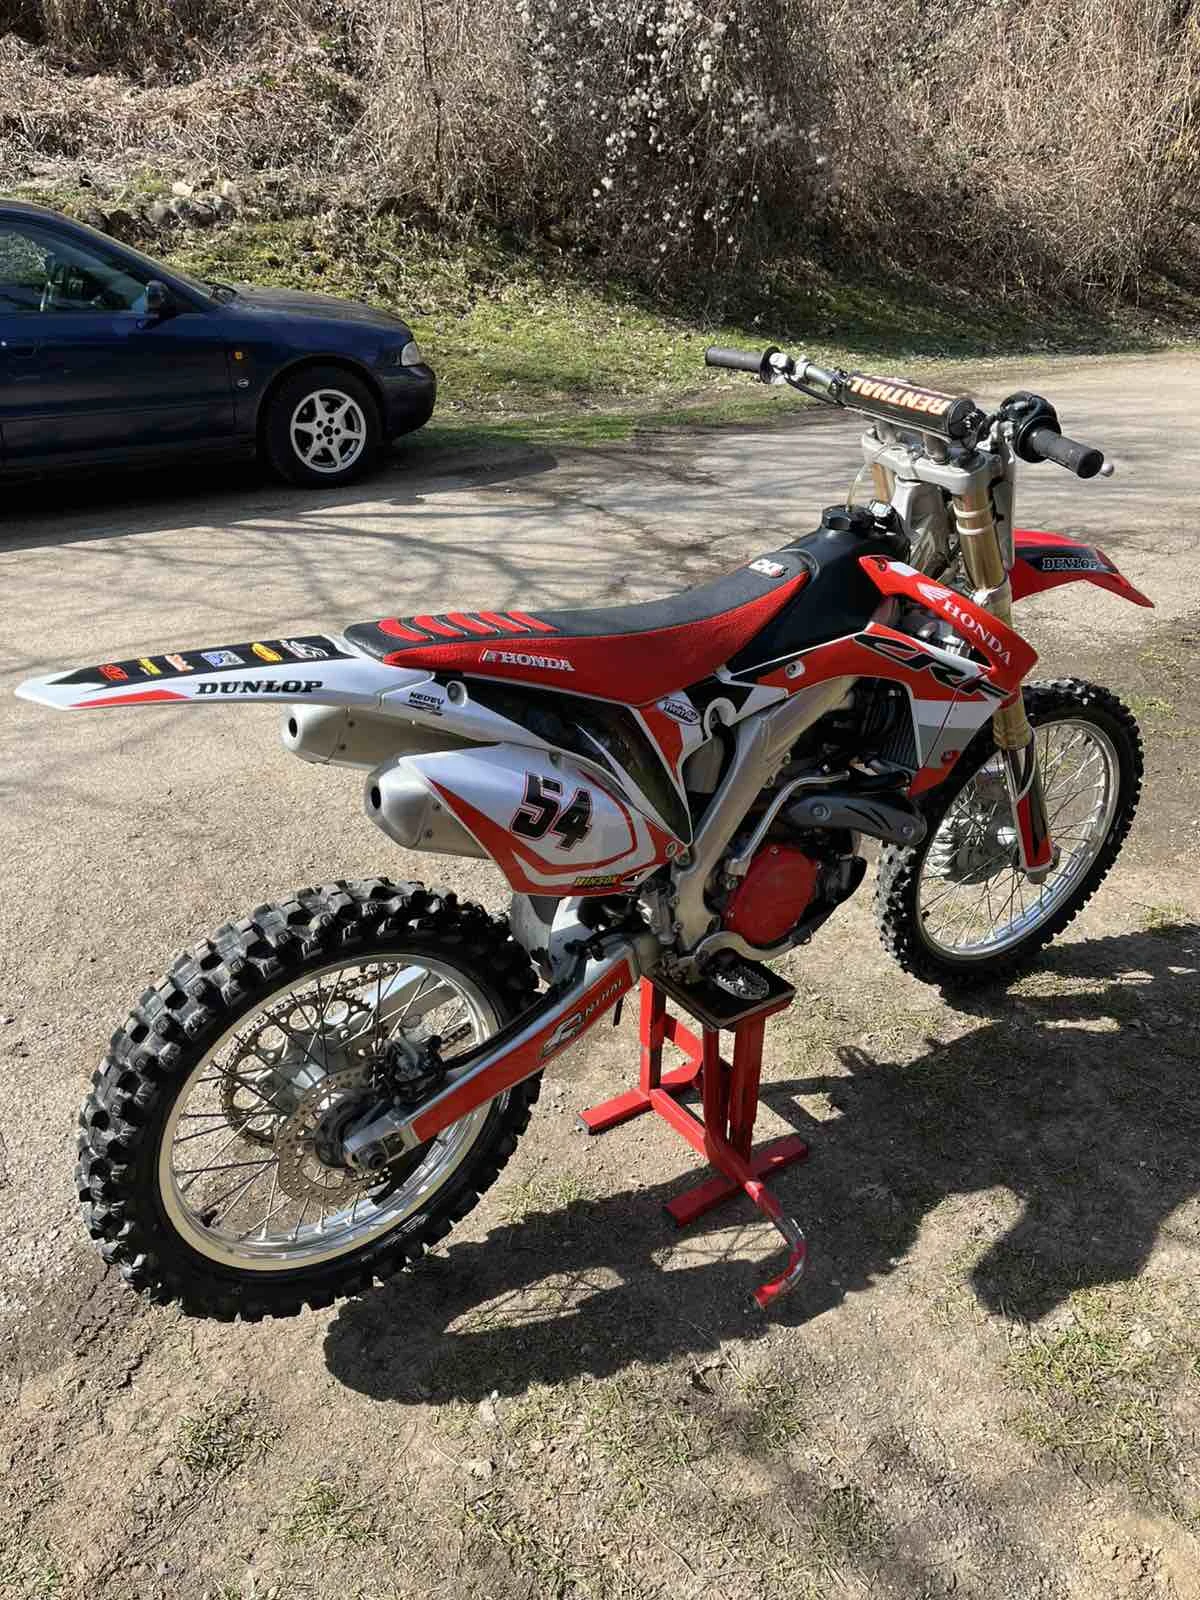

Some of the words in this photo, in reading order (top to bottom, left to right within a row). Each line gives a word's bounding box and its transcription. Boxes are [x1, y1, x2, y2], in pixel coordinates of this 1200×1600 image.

[850, 376, 953, 416] RENTHAL
[943, 600, 1011, 665] HONDA
[501, 651, 576, 671] HONDA
[195, 679, 323, 695] DUNLOP
[509, 769, 592, 852] 54
